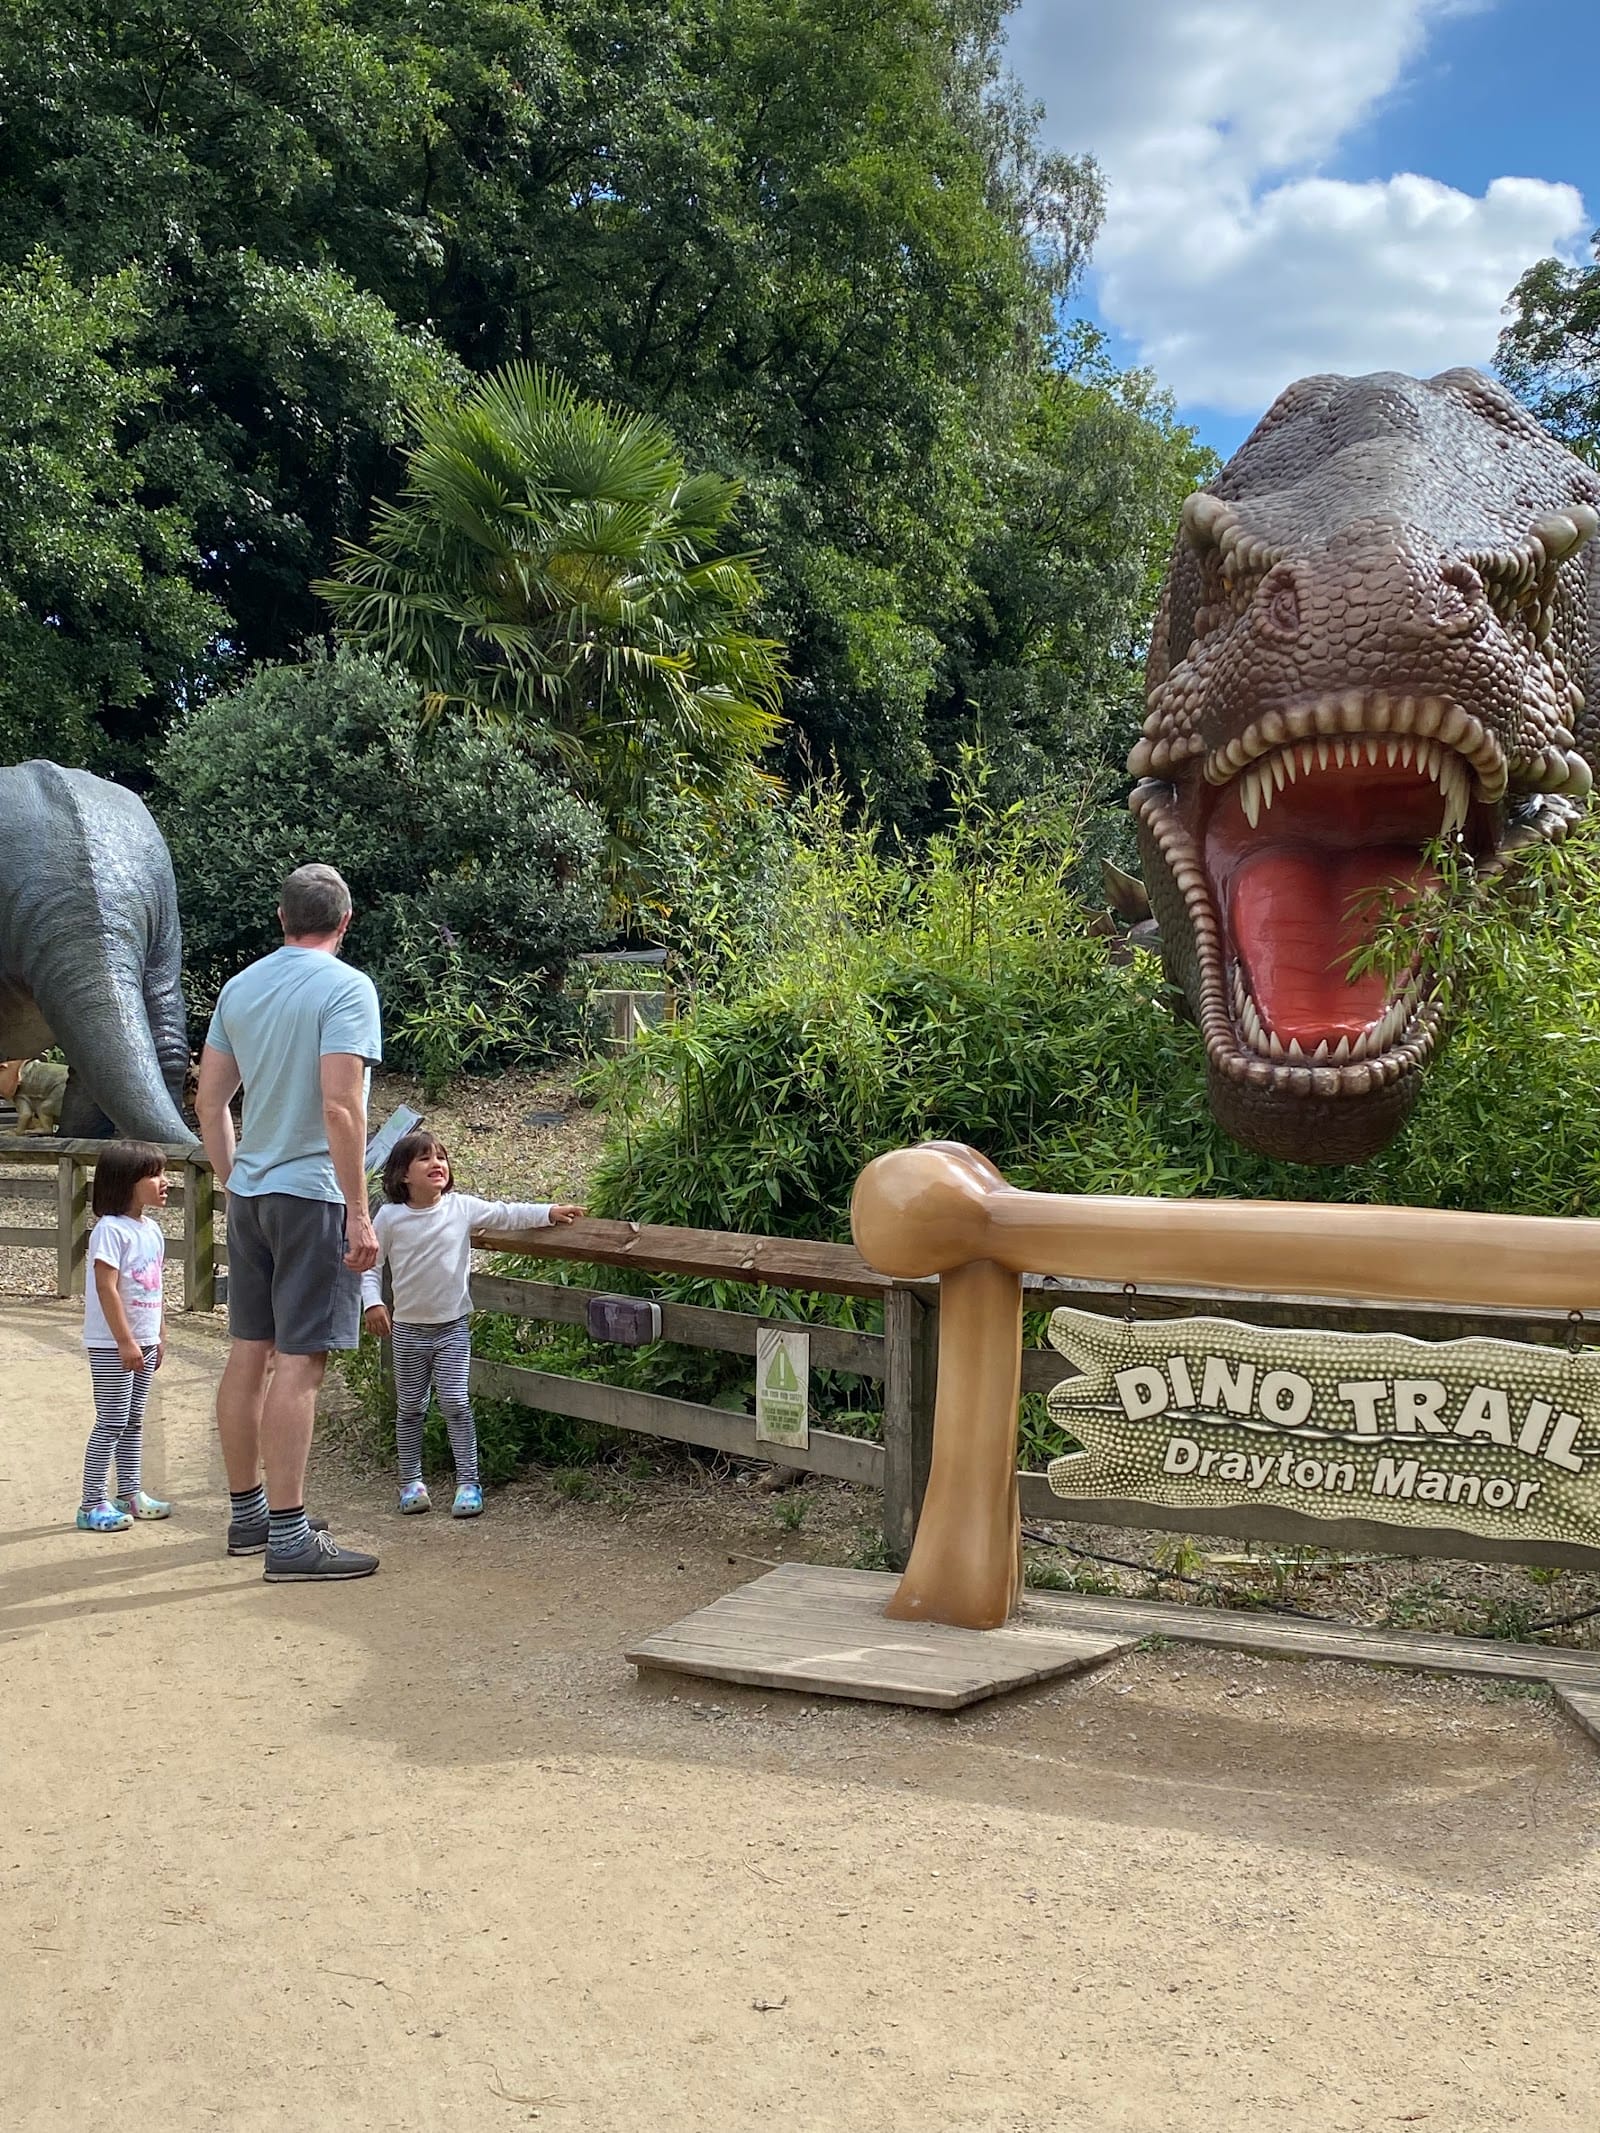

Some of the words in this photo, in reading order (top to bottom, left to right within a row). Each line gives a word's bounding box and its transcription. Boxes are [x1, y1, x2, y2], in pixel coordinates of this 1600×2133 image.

[1113, 1356, 1313, 1427] DINO
[1338, 1379, 1583, 1473] TRAIL
[1163, 1438, 1356, 1490] Drayton
[1371, 1459, 1541, 1510] Manor
